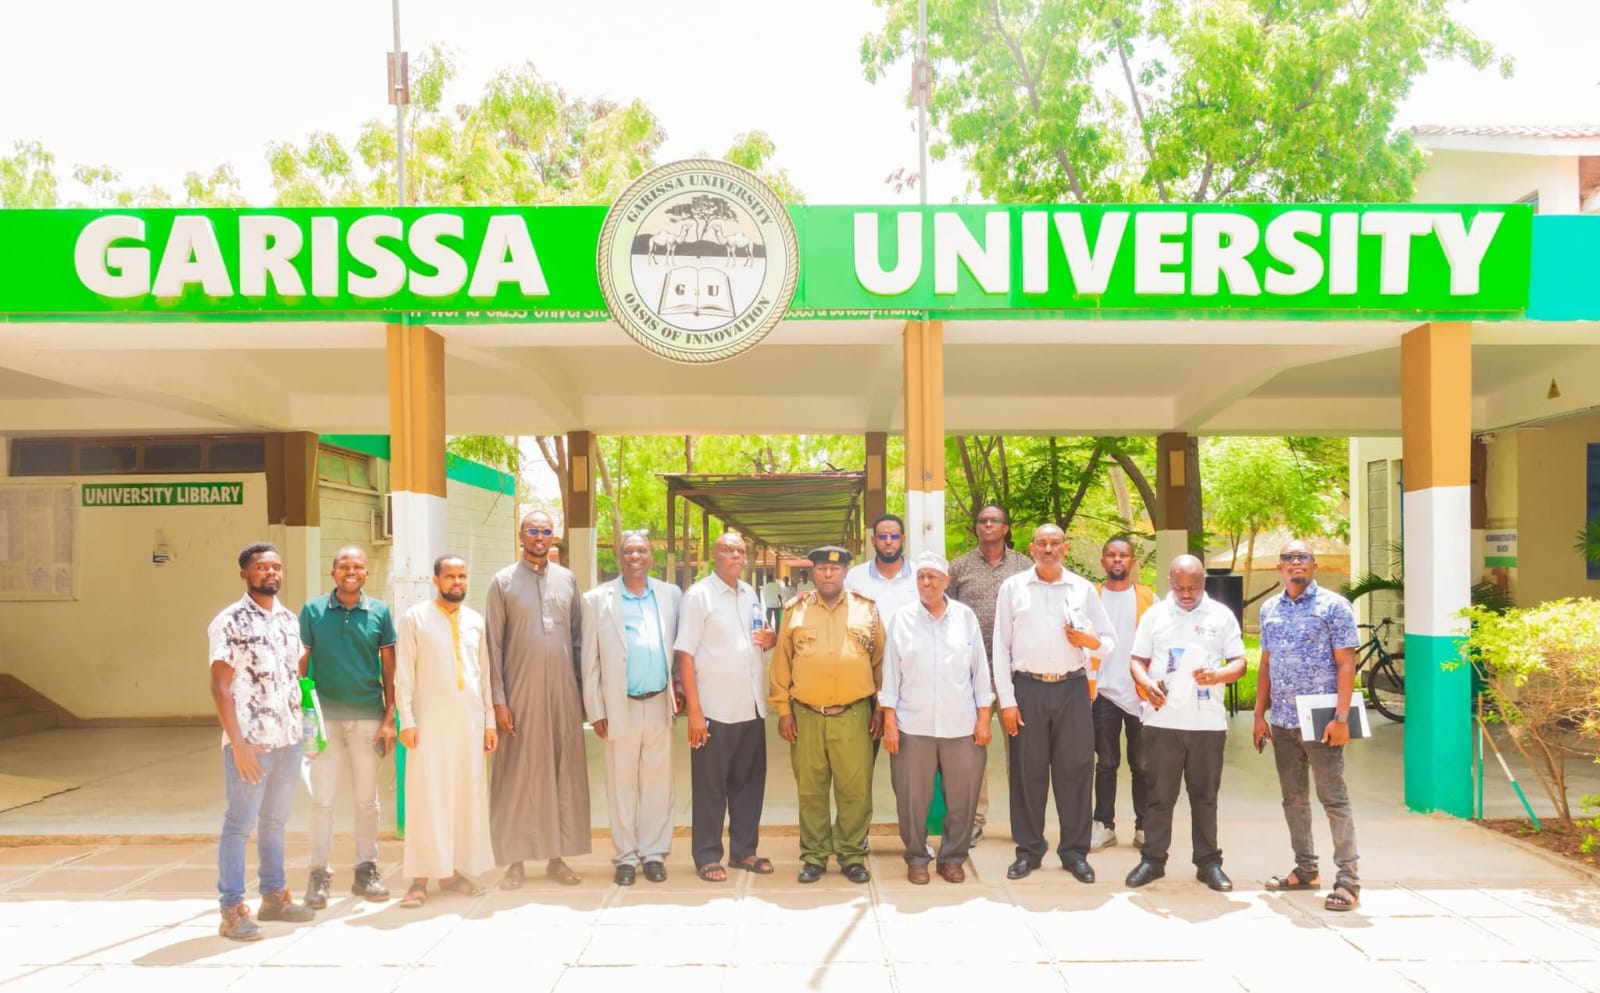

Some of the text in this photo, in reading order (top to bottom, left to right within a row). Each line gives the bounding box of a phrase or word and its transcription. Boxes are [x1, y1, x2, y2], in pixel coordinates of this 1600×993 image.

[626, 174, 773, 225] GARISSA UNIVERSITY
[74, 209, 1506, 299] GARISSA UNIVERSITY
[675, 284, 720, 297] G U
[624, 292, 771, 345] OASIS OF INNOVATION
[85, 485, 240, 504] UNIVERSITY LIBRARY
